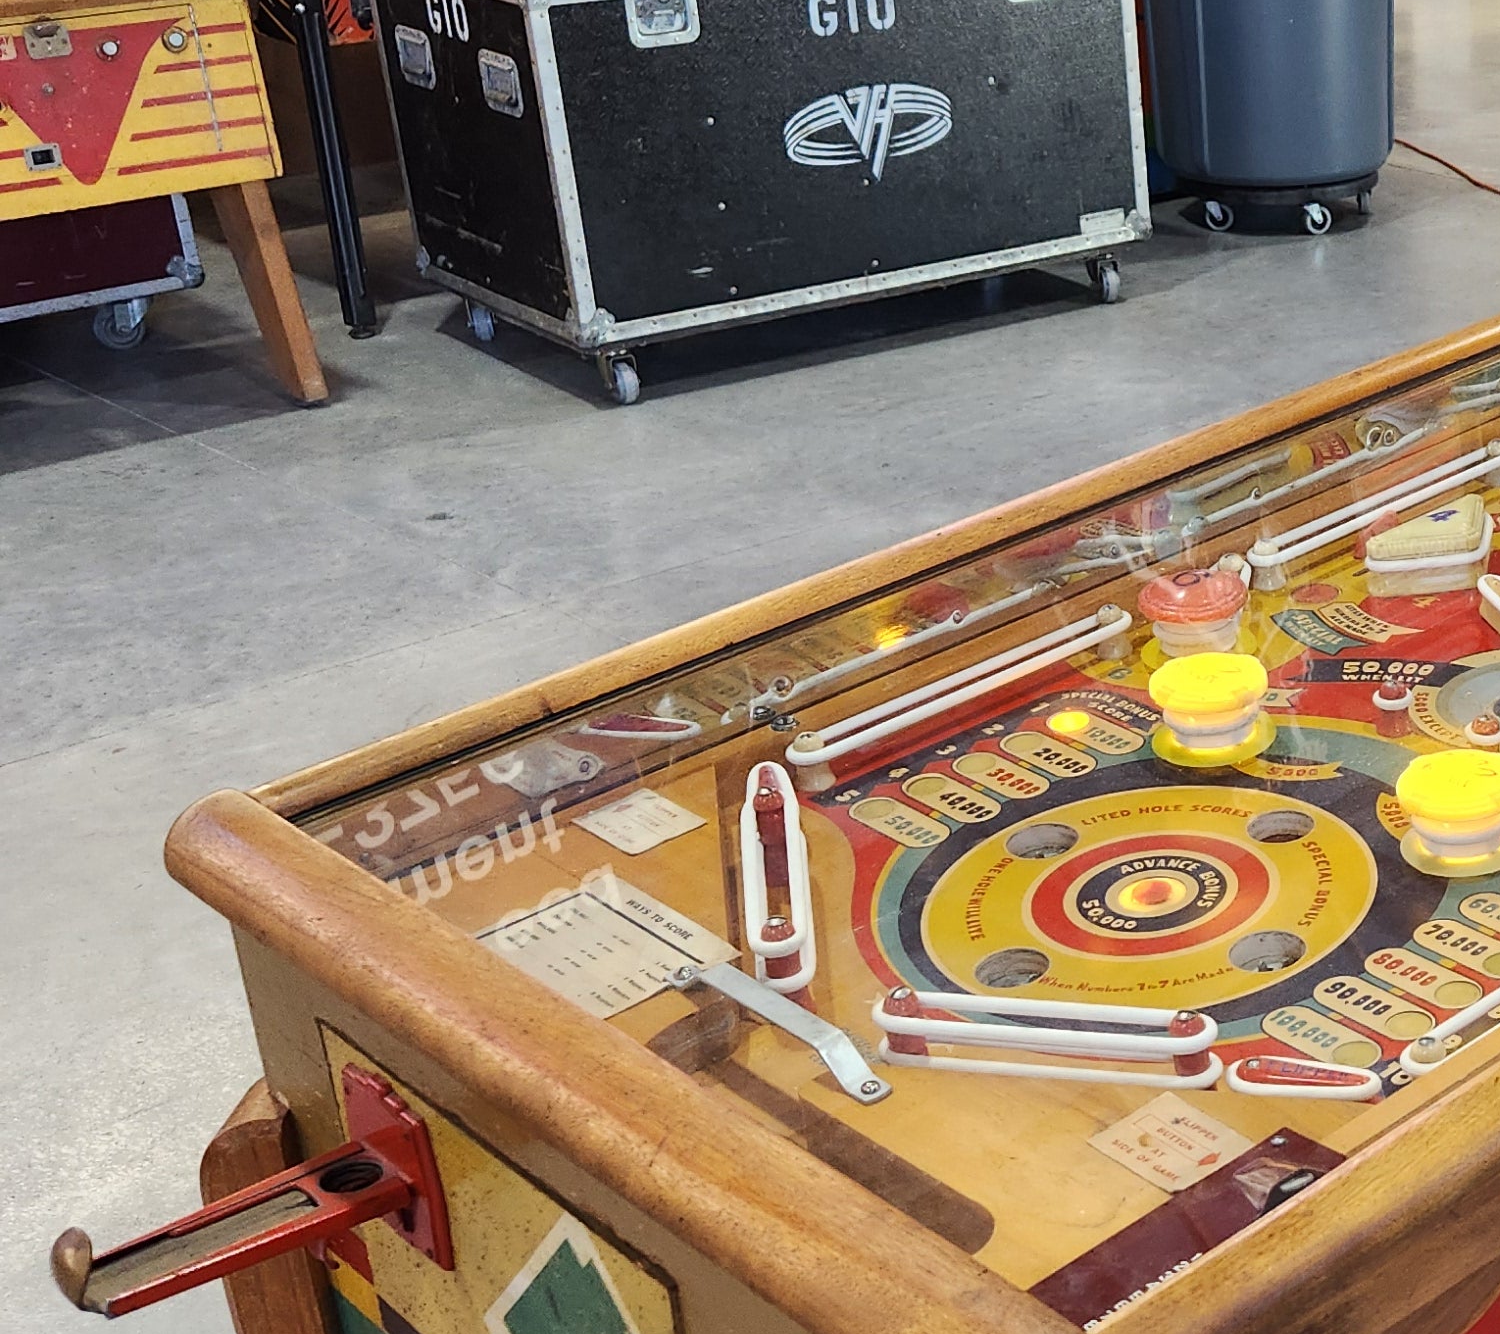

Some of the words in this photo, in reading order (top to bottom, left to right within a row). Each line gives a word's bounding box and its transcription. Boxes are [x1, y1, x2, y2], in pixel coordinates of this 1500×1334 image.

[1292, 613, 1344, 645] SPECIAL
[1060, 691, 1118, 708] SPECIAL
[1116, 699, 1161, 722] BONUS
[1087, 701, 1133, 723] SCORE
[835, 789, 861, 802] 5
[1081, 809, 1131, 826] LITED
[1139, 804, 1184, 815] HOLE
[1190, 805, 1252, 818] SCORES
[994, 857, 1014, 876] ONE
[1301, 841, 1333, 884] SPECIAL
[972, 874, 996, 897] HOLE
[1120, 857, 1202, 875] ADVANCE
[1196, 870, 1222, 908] BONUS
[626, 898, 652, 915] WAYS
[650, 912, 663, 924] TO
[663, 920, 694, 942] SCORE
[1297, 889, 1332, 927] BONUS
[1039, 975, 1073, 990] When
[1076, 981, 1135, 992] Numbers
[1172, 976, 1195, 987] Are
[1195, 967, 1234, 982] Made
[1156, 1127, 1195, 1151] BUTTON
[1112, 1138, 1134, 1154] SIDE
[1152, 1163, 1181, 1182] GAME
